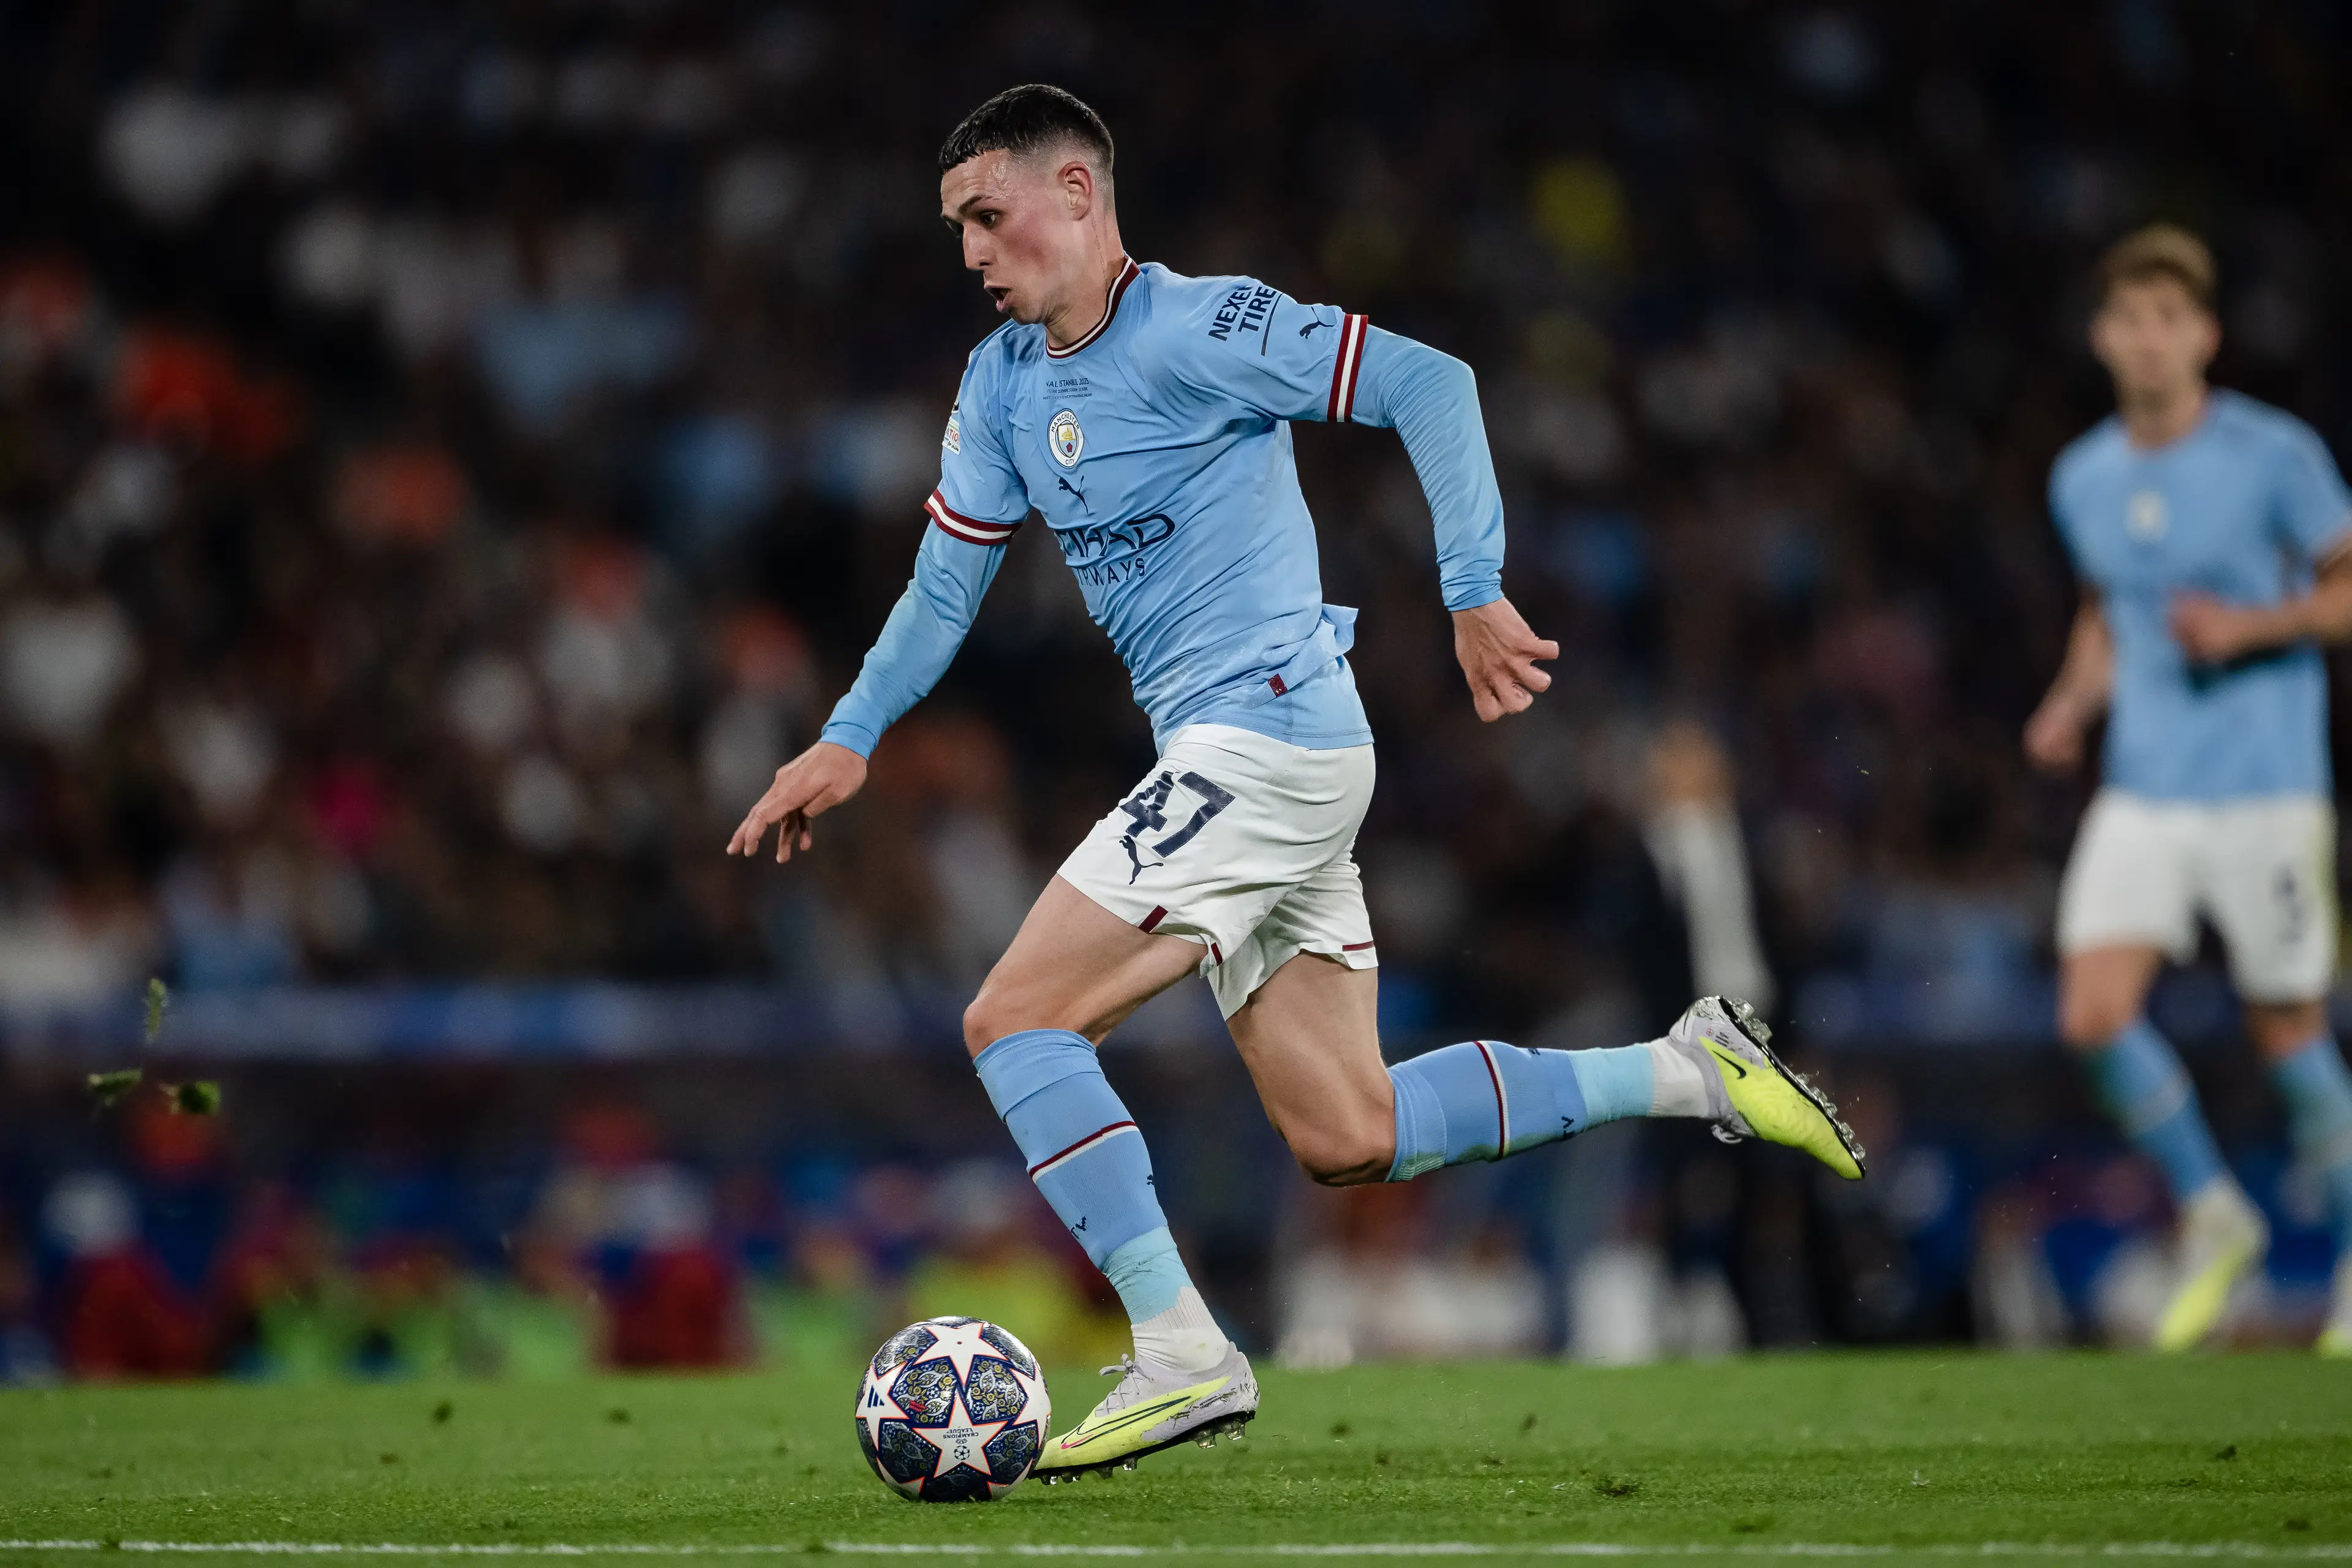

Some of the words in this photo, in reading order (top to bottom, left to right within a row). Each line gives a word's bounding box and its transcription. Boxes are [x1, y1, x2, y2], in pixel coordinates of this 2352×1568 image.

[1237, 286, 1277, 333] TIRE
[1051, 413, 1079, 432] MANCHESTER
[1054, 513, 1175, 557] TIHAD
[1077, 558, 1145, 586] IRWAYS
[1118, 771, 1236, 858] 47
